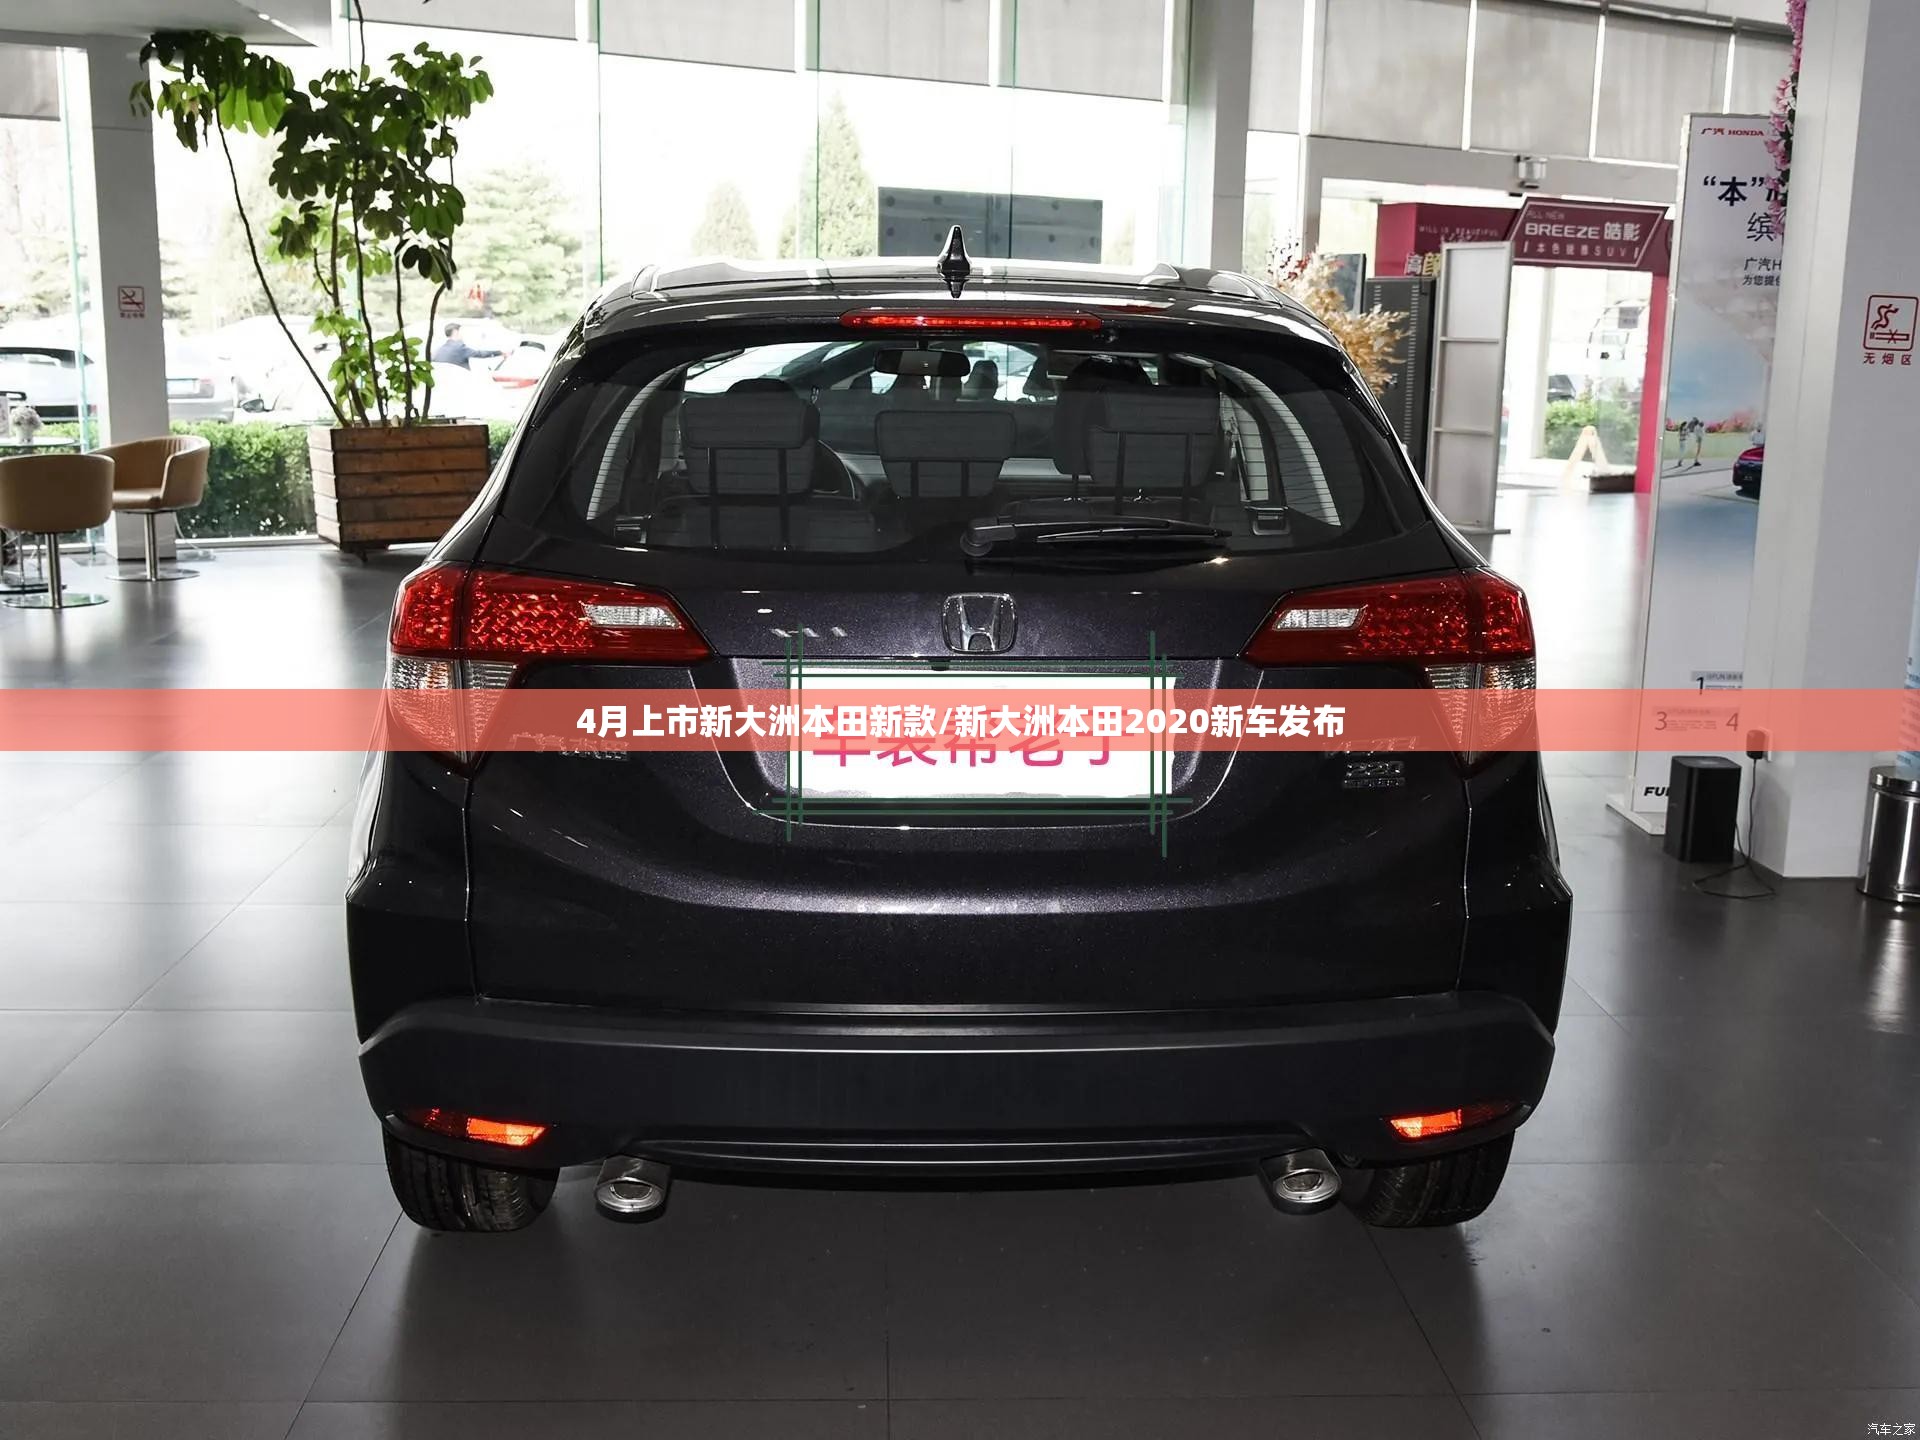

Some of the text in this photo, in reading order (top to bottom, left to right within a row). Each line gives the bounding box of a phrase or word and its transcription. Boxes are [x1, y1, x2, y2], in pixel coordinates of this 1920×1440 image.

[1701, 127, 1725, 136] 广汽
[1524, 221, 1641, 242] BREEZE 皓影
[1746, 212, 1775, 241] 缤
[1863, 352, 1912, 366] 无烟区
[1696, 677, 1704, 695] 1
[1654, 711, 1668, 731] 3
[1725, 712, 1739, 732] 4
